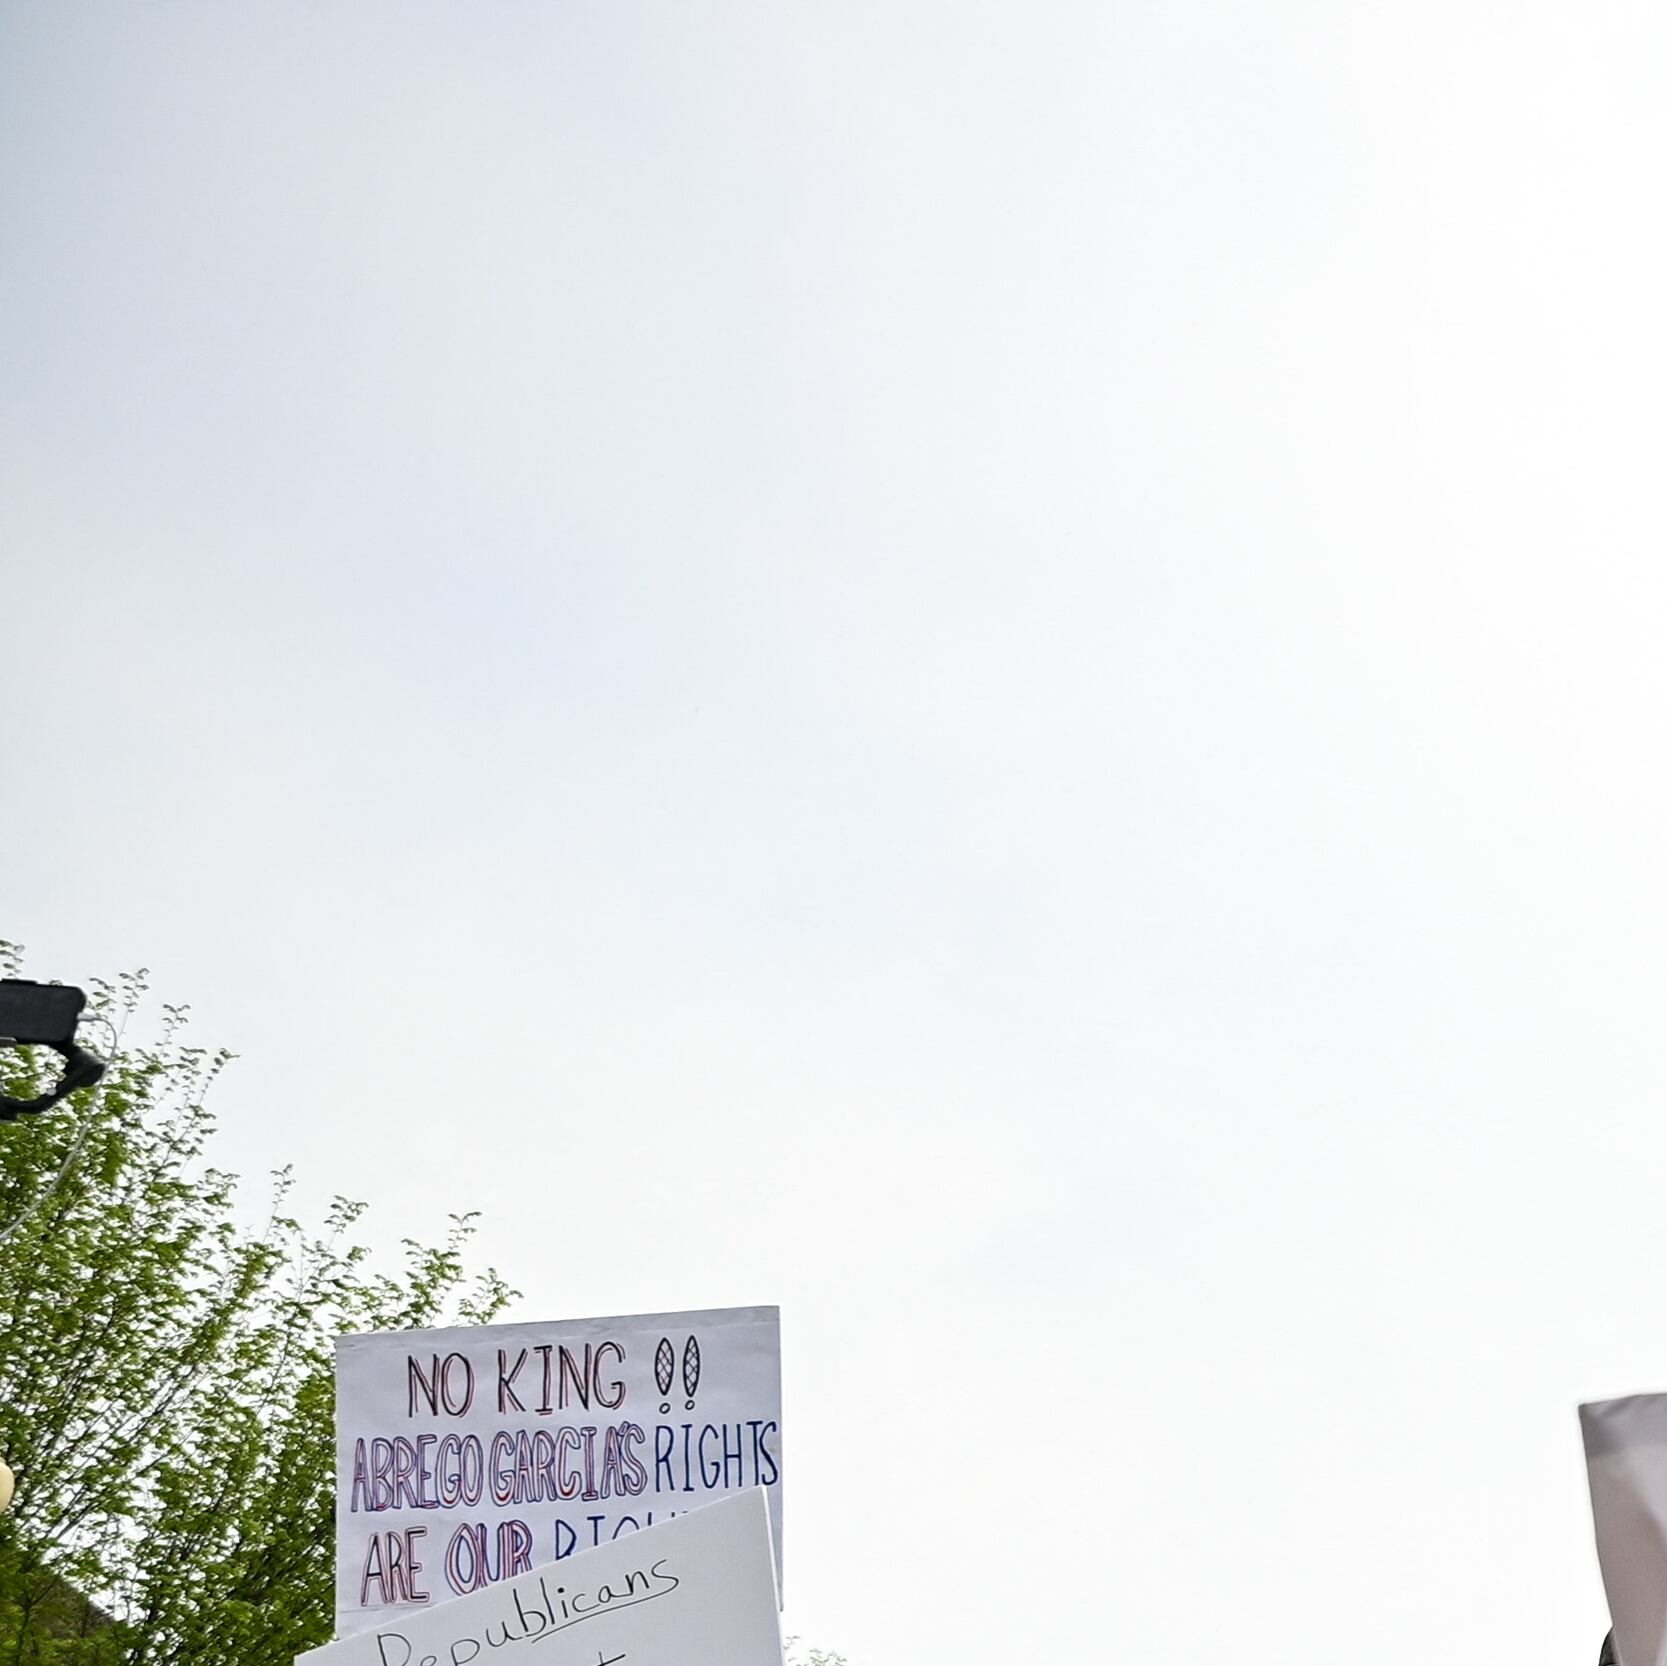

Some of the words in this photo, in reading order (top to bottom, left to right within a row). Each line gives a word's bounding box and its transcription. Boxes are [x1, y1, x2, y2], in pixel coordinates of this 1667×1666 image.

[407, 1352, 475, 1418] NO
[497, 1341, 627, 1416] KING
[351, 1433, 483, 1513] ABREGO
[489, 1421, 648, 1506] GARCIA'S
[654, 1420, 779, 1493] RIGHTS
[360, 1525, 430, 1607] ARE
[444, 1519, 534, 1597] OUR
